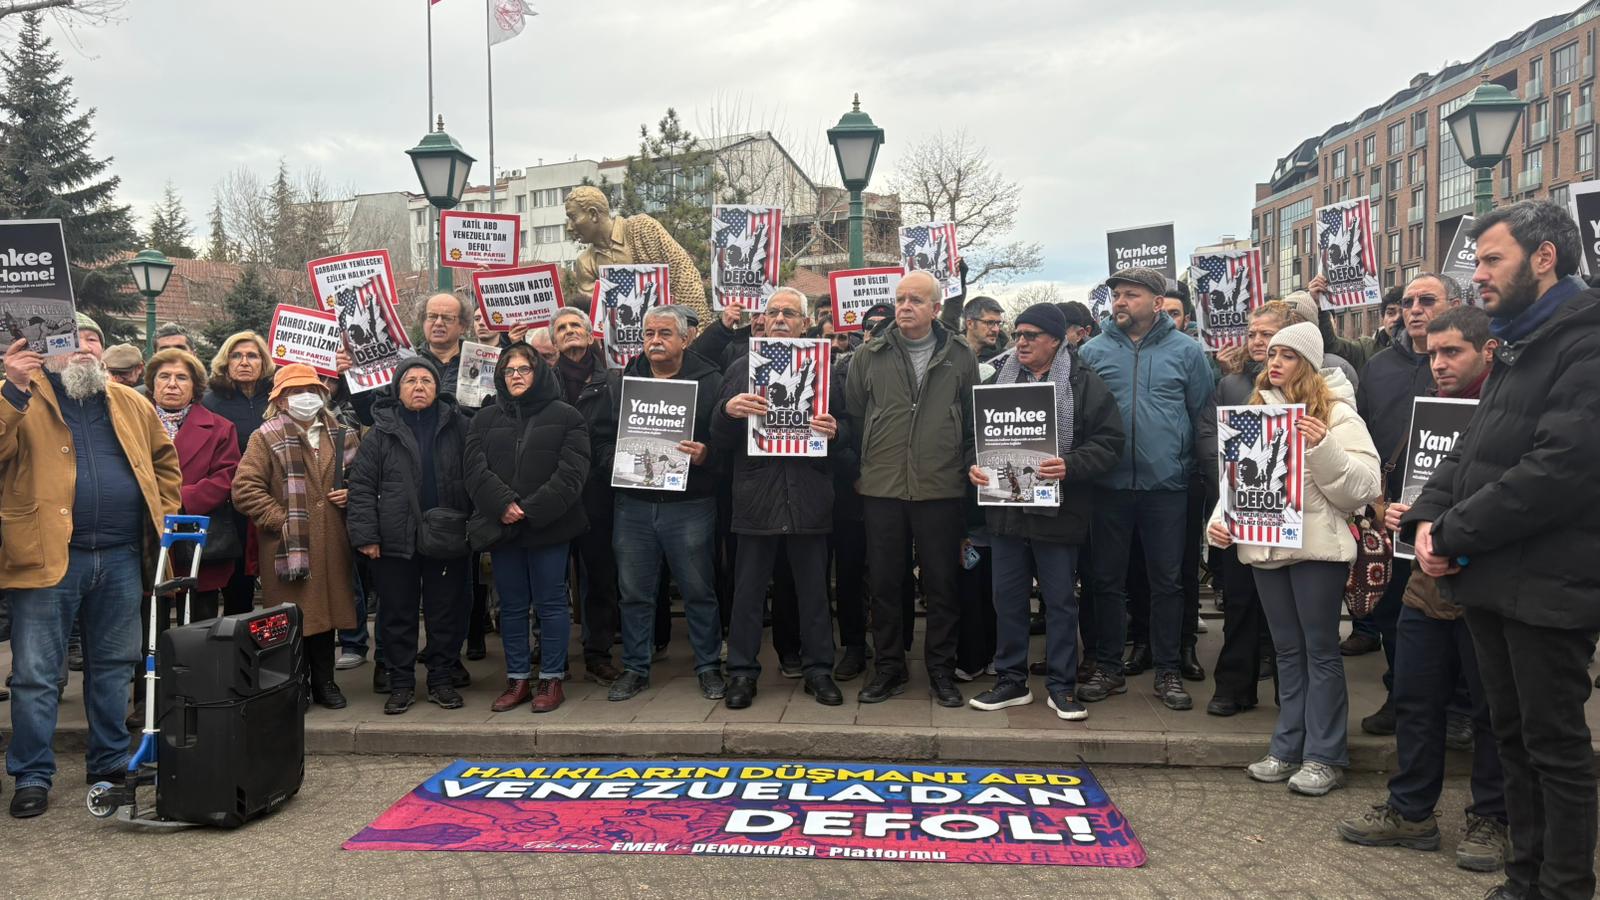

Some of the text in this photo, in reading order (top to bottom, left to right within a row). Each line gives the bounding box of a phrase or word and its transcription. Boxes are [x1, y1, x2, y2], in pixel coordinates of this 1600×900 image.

[462, 219, 498, 230] KATİL ABD
[453, 230, 507, 242] VENEZUELA'DAN
[467, 242, 492, 251] DEFOL!
[1115, 244, 1167, 259] Yankee
[1116, 256, 1167, 270] Go Home!
[1457, 250, 1476, 261] Go
[315, 257, 383, 275] BARBARLIK YENİLECEK!
[1328, 266, 1364, 282] DEFOL
[327, 273, 347, 283] EZİLEN
[724, 269, 763, 285] DEFOL
[853, 275, 888, 286] ABD ÜSLERİ
[480, 278, 553, 295] KAHROLSUN NATO!
[853, 287, 890, 297] KAPATILSIN!
[485, 291, 554, 307] KAHROLSUN ABD!
[842, 299, 874, 309] NATO'DAN
[278, 315, 326, 335] KAHROLSUN
[1210, 311, 1248, 326] DEFOL
[275, 330, 341, 352] EMPERYALİZMİ
[354, 339, 397, 364] DEFOL
[630, 399, 687, 416] Yankee
[984, 407, 1046, 423] Yankee
[628, 414, 686, 428] Go Home!
[766, 410, 811, 426] DEFOL
[984, 424, 1047, 437] Go Home!
[1414, 451, 1433, 468] Go
[1236, 490, 1284, 509] DEFOL
[1281, 527, 1297, 536] SOL
[461, 765, 1082, 785] HALKLARIN DÜŞMANI ABD
[444, 780, 1086, 806] VENEZUELA'DAN
[725, 809, 1096, 842] DEFOL!
[610, 842, 669, 852] EMEK
[691, 843, 815, 856] DEMOKRASİ
[829, 846, 947, 860] Platformu
